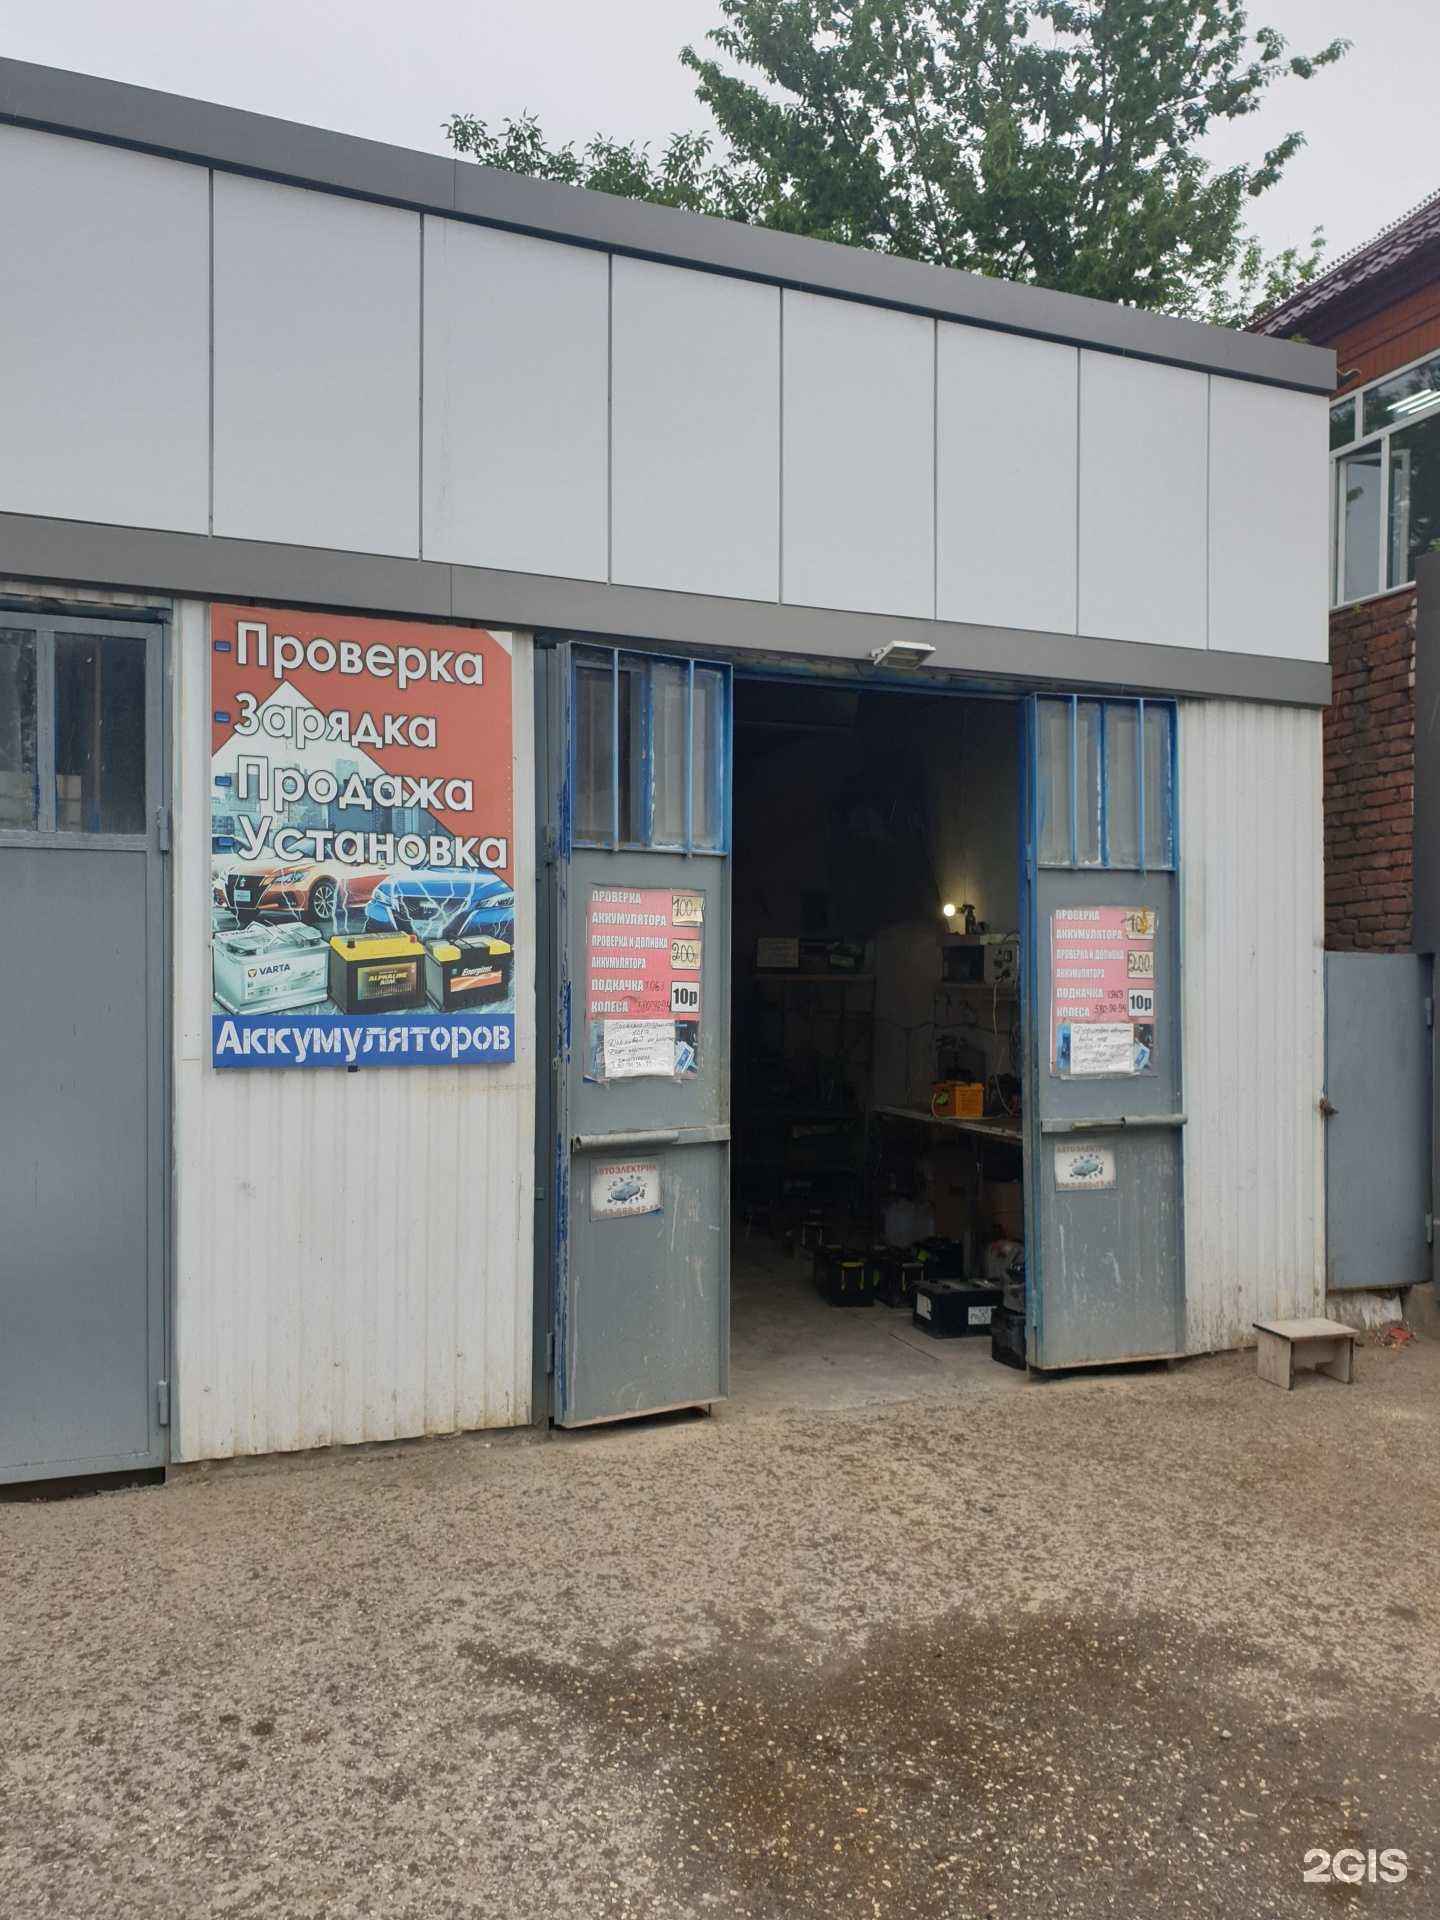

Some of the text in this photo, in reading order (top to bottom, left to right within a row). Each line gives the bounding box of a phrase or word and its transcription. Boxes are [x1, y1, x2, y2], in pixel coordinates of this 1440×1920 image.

[235, 620, 484, 689] Проверка
[233, 692, 438, 749] Зарядка
[236, 754, 474, 812] Продажа
[238, 814, 508, 870] Установка
[259, 963, 291, 976] VARTA
[592, 1000, 629, 1013] КОЛЕСА
[673, 988, 698, 1006] 10р
[216, 1020, 511, 1063] Аккумуляторов
